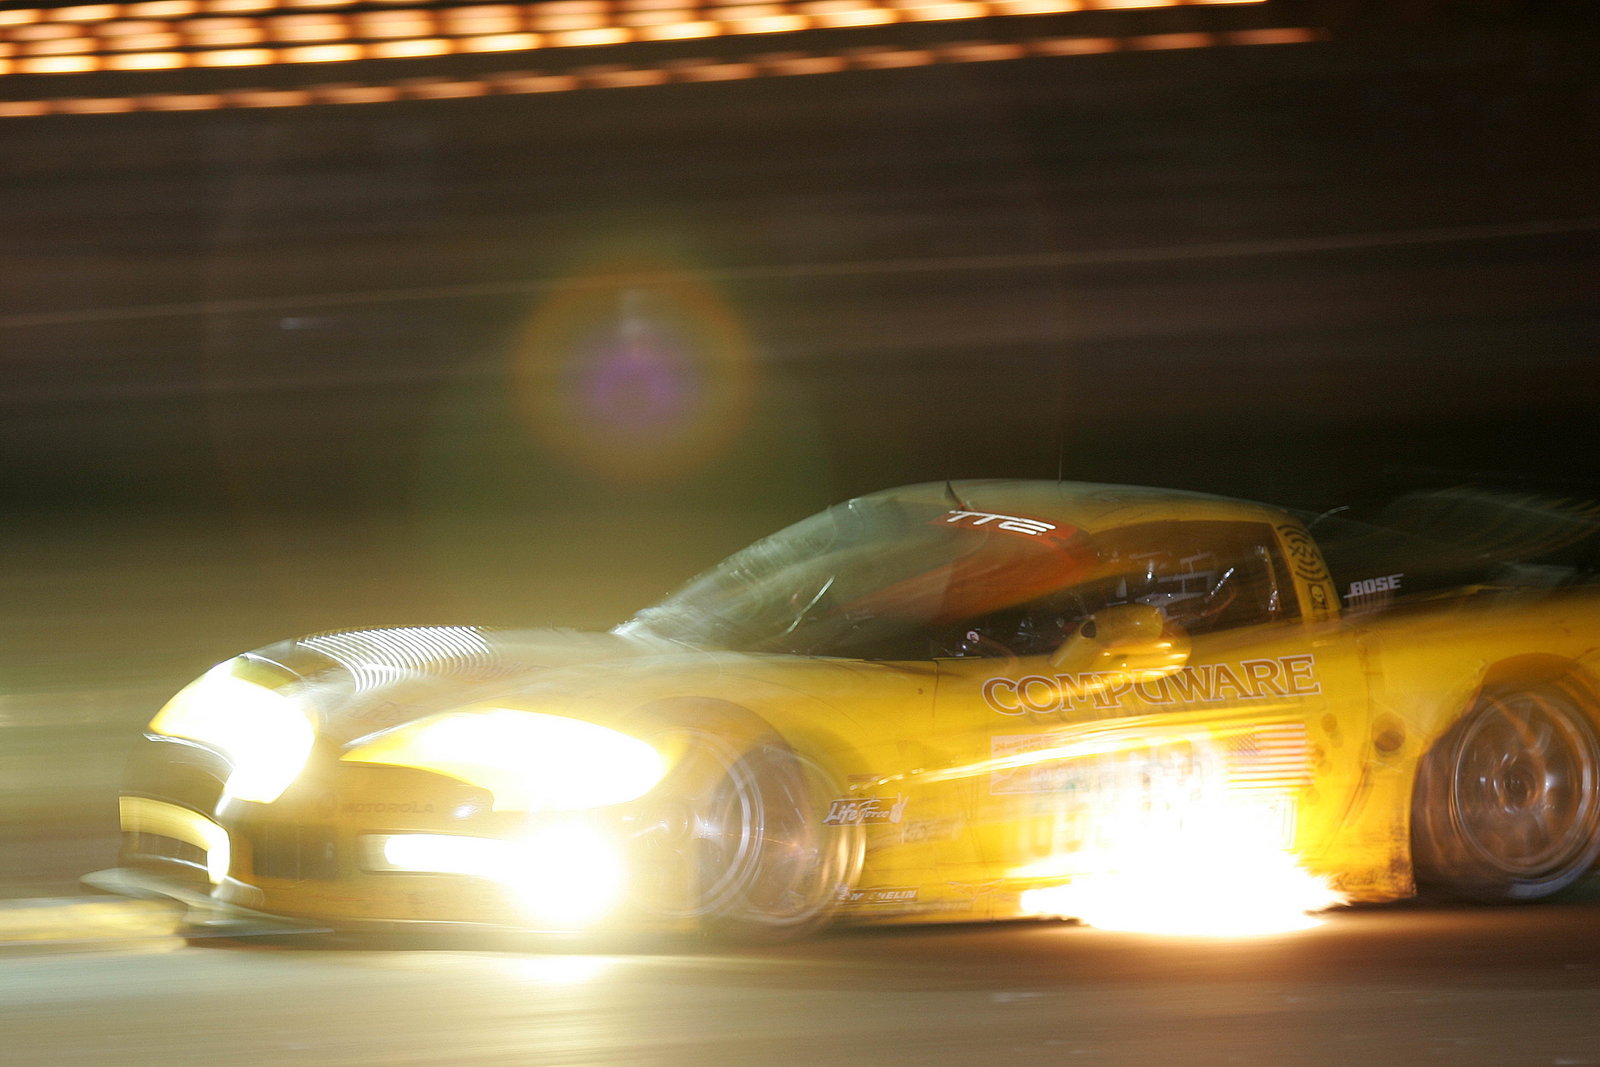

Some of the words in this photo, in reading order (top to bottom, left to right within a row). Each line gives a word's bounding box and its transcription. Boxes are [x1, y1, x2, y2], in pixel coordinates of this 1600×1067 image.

[1343, 573, 1404, 599] BOSE
[982, 653, 1321, 716] COMPUWARE
[850, 890, 917, 901] MCHELIN
